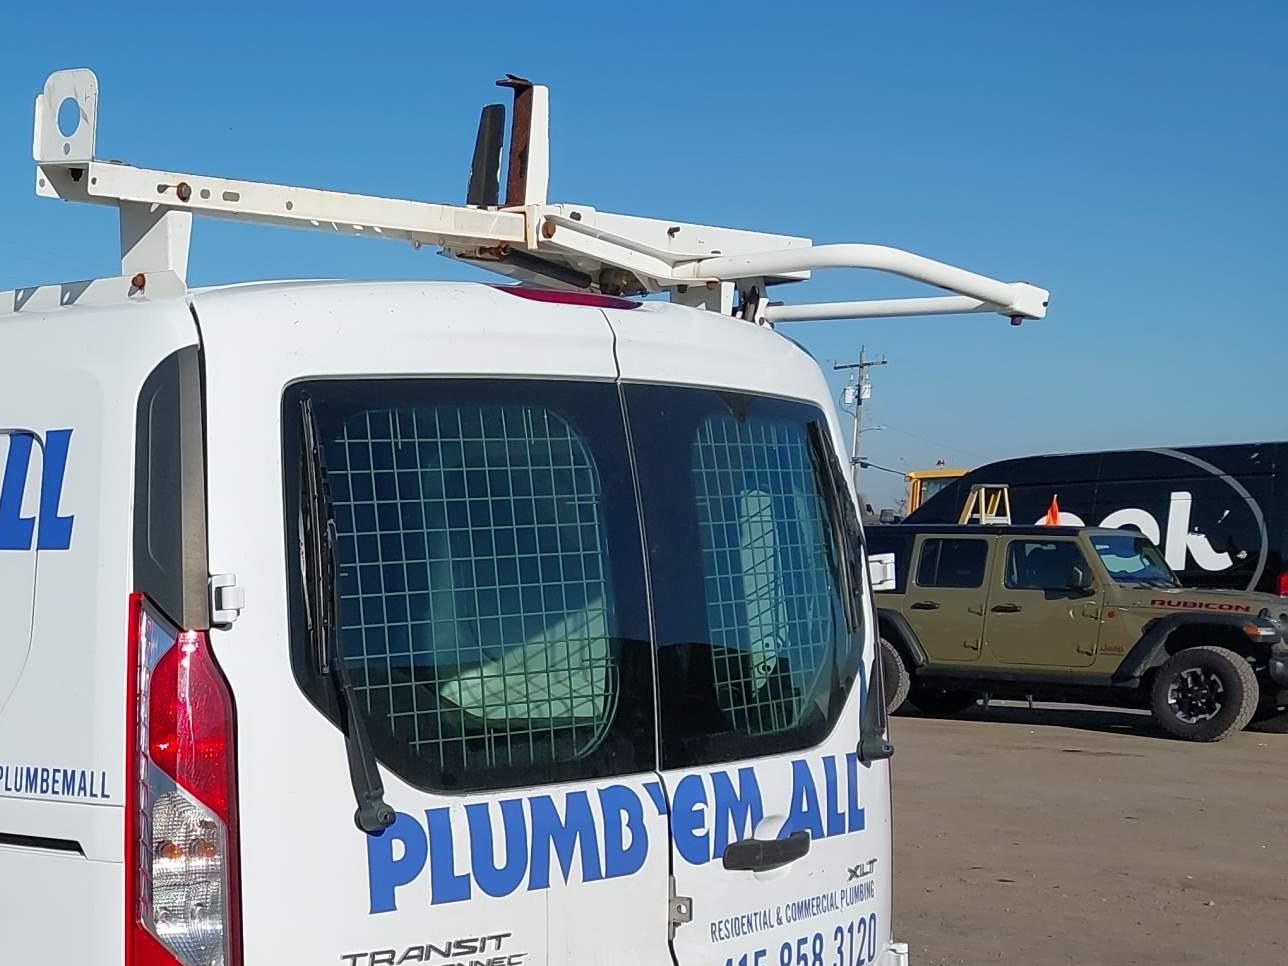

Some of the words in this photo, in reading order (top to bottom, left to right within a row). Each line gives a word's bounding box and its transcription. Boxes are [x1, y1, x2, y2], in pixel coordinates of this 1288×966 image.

[1150, 599, 1251, 612] RUBICON
[776, 752, 866, 842] ALL
[846, 858, 878, 882] XLT
[711, 908, 775, 943] RESIDENTIAL
[776, 906, 783, 925] &
[785, 891, 840, 922] COMMERCIAL
[840, 879, 875, 908] PLUMBING
